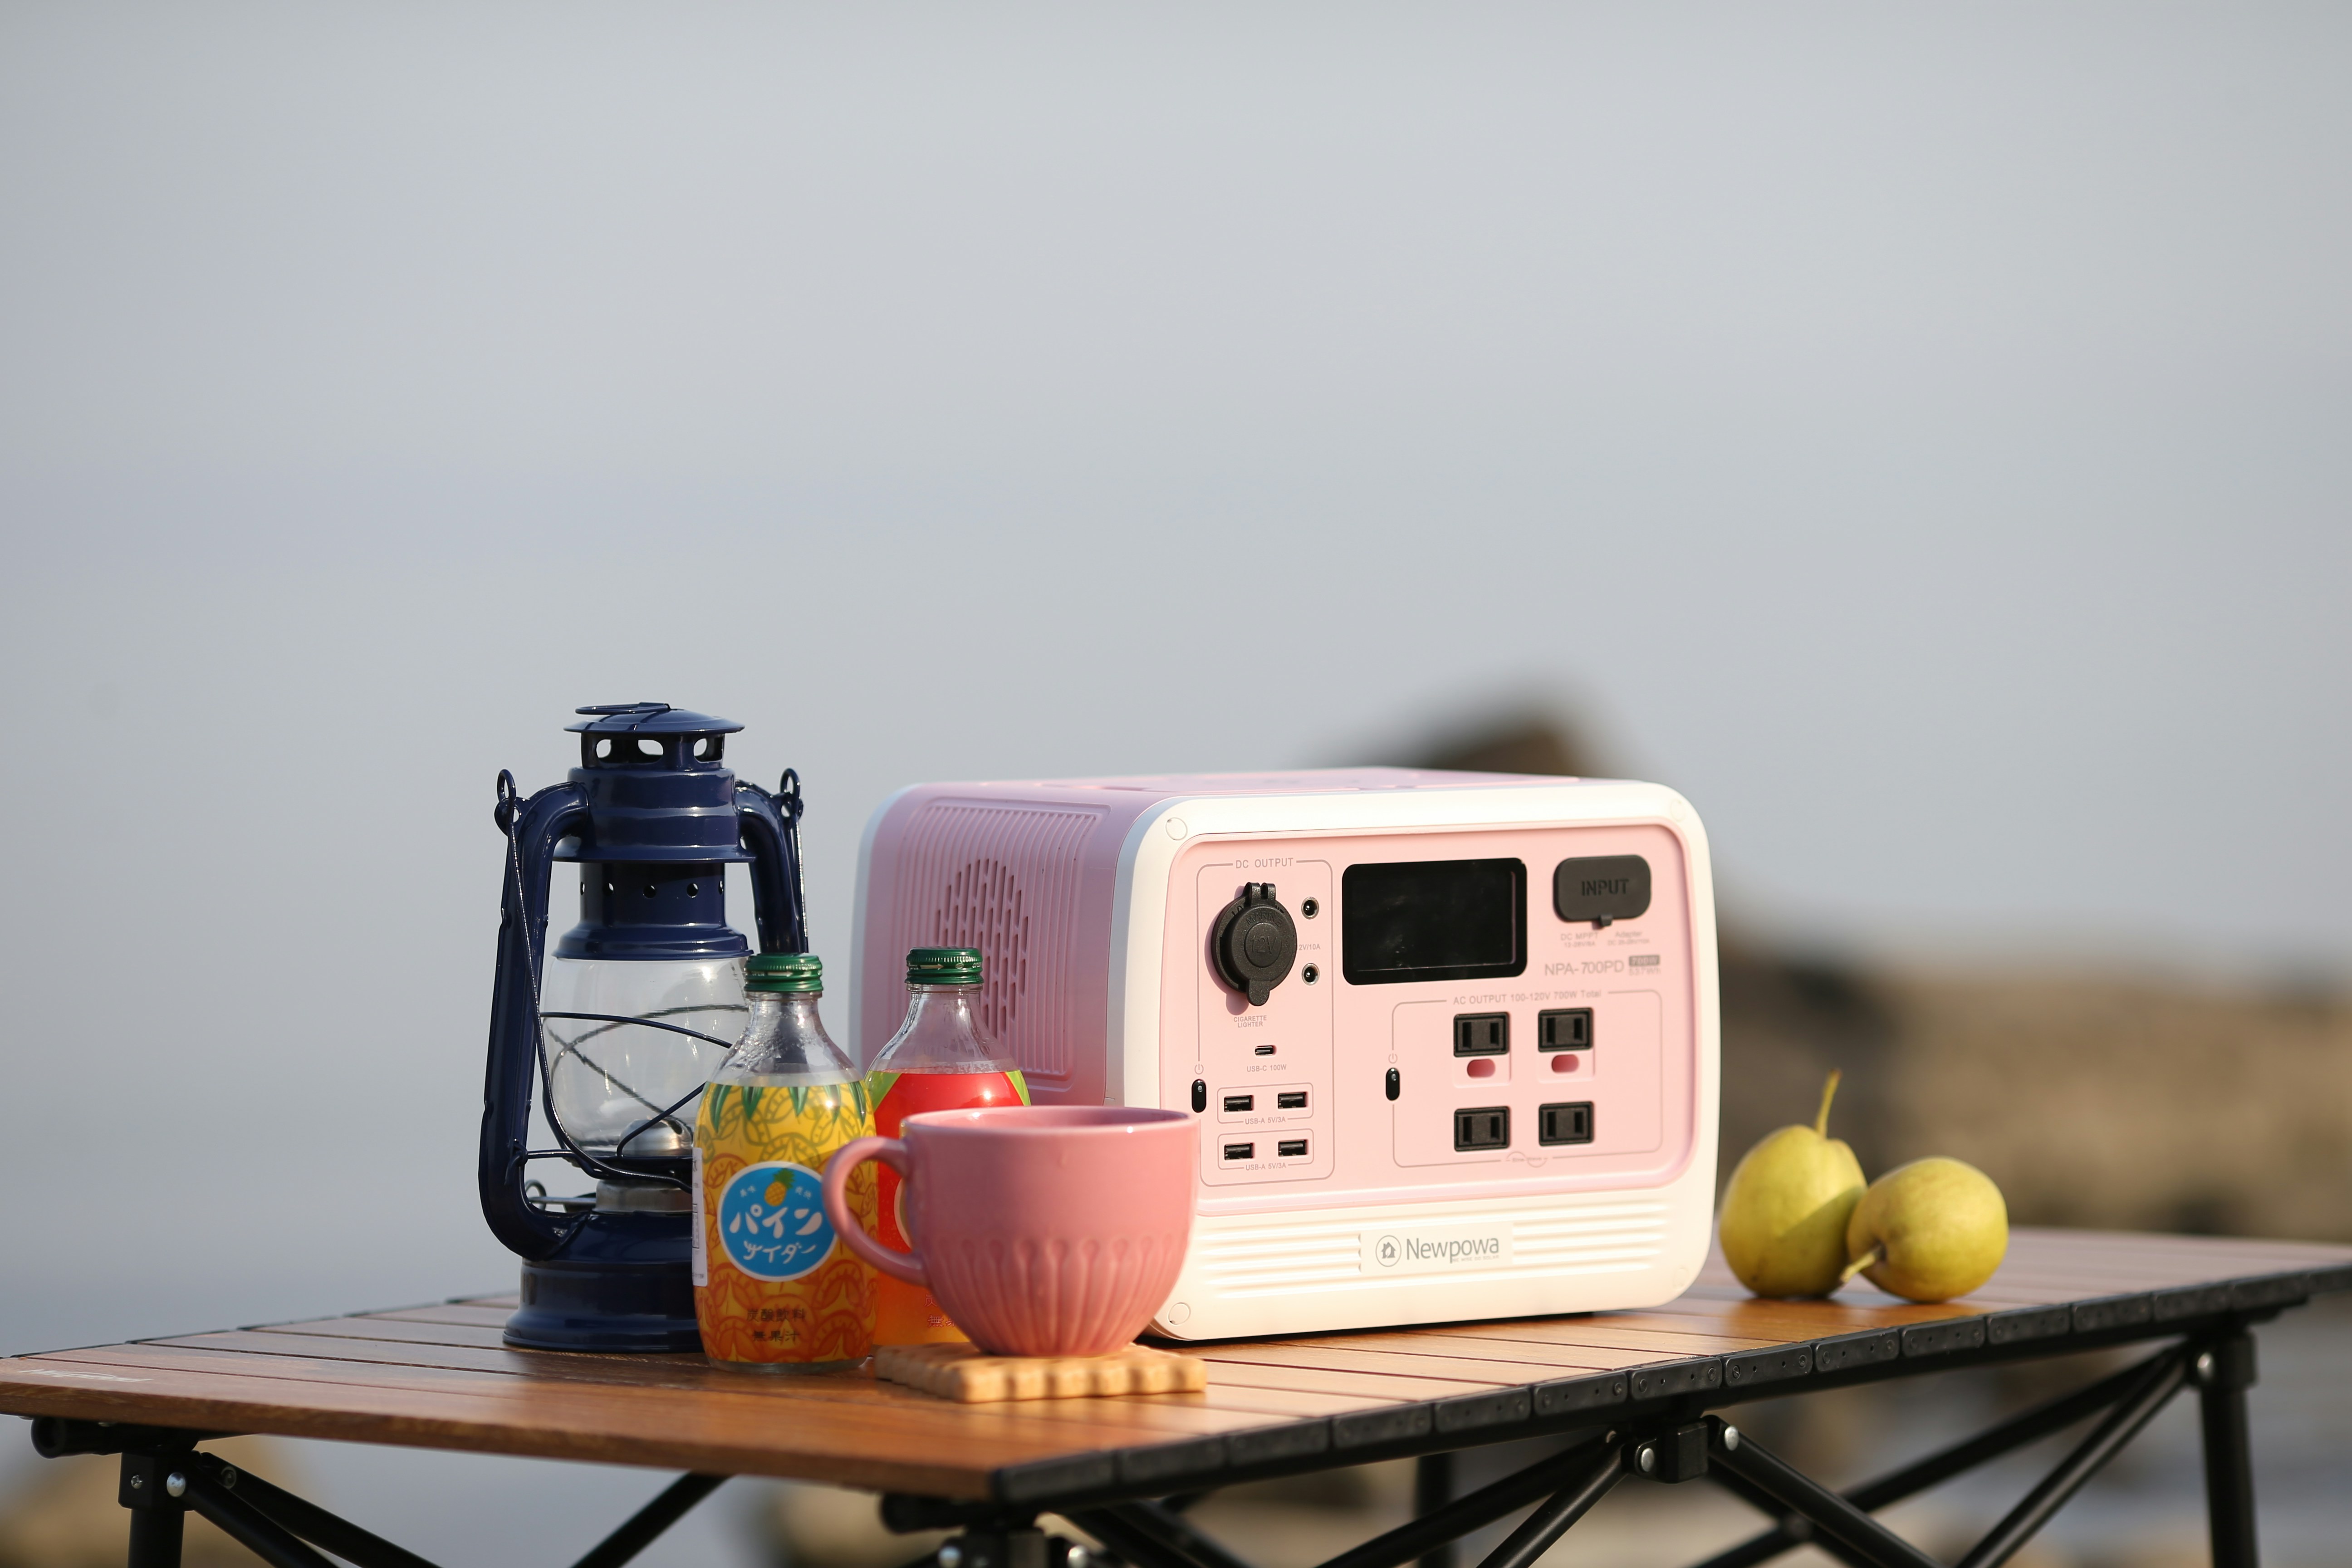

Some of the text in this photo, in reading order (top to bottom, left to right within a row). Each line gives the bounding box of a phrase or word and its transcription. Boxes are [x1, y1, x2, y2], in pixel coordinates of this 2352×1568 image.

[1236, 858, 1293, 868] DC OUTPUT
[1582, 879, 1629, 896] INPUT
[1246, 911, 1283, 928] MARINE
[1250, 935, 1277, 954] 12V
[1632, 957, 1658, 965] 700W
[1453, 990, 1602, 1005] AC OUTPUT 100-120V 700W Total
[729, 1204, 823, 1239] パイン
[743, 1240, 816, 1264] サイダー
[1406, 1237, 1499, 1264] Newpowa
[747, 1308, 805, 1322] 炭酸飲料
[752, 1329, 800, 1344] 無果汁
